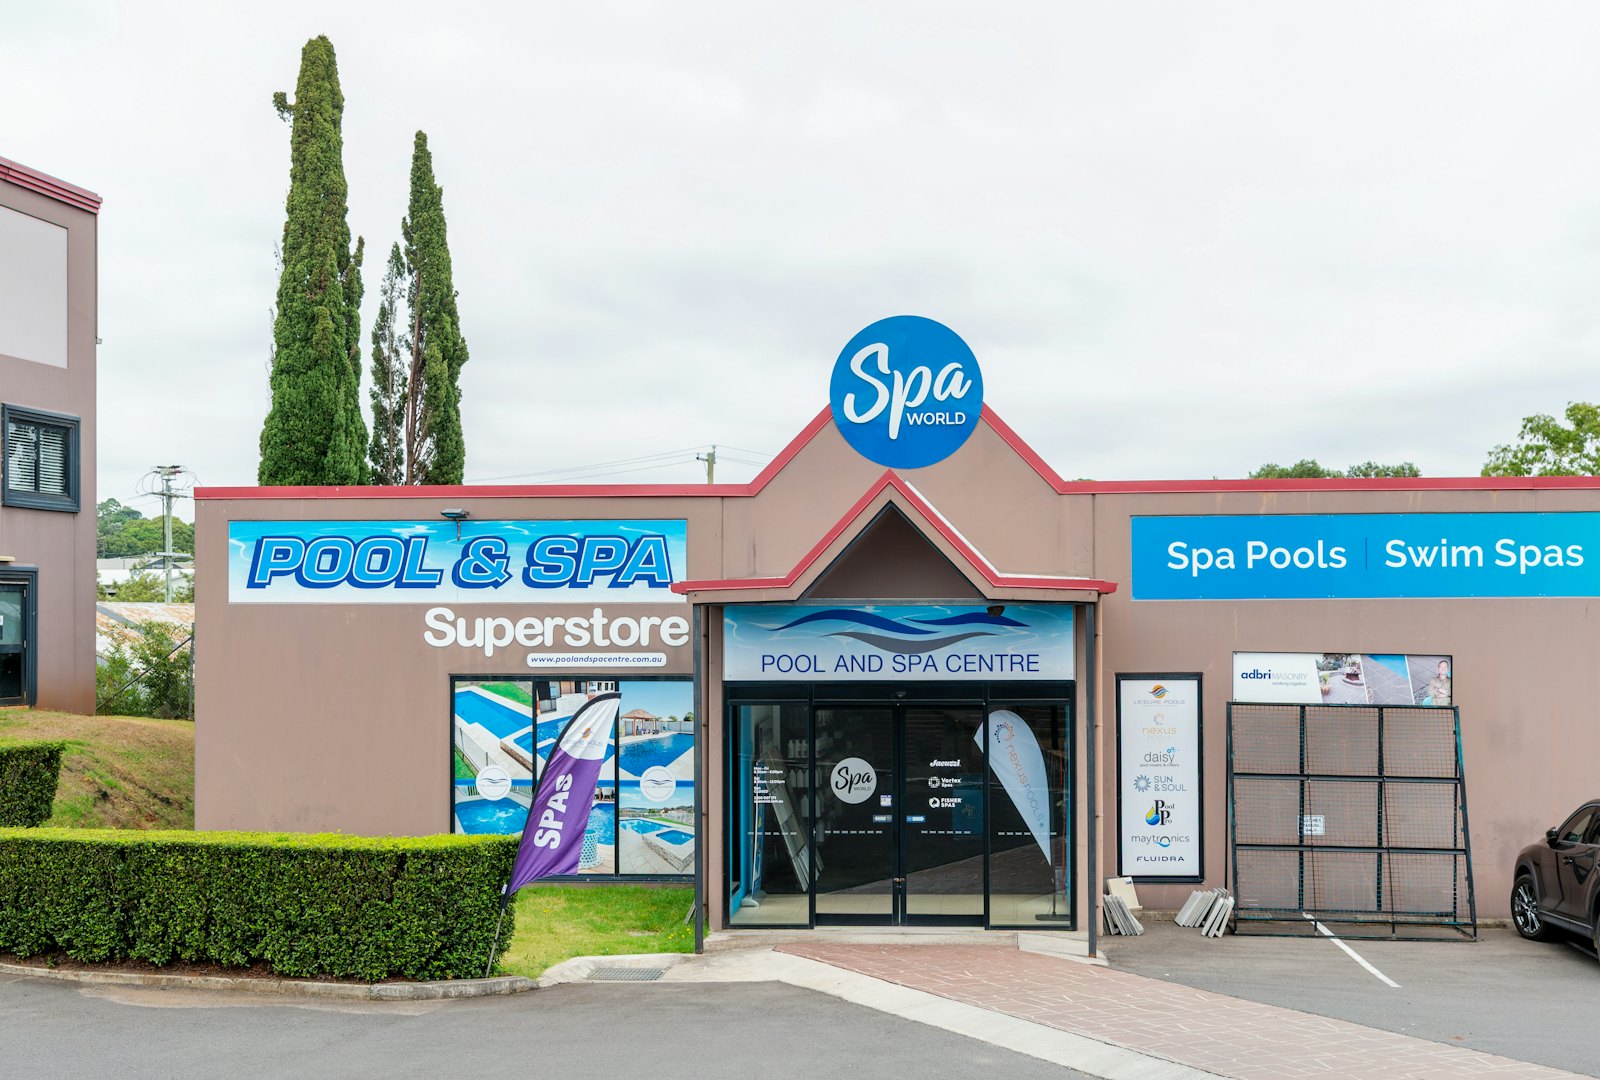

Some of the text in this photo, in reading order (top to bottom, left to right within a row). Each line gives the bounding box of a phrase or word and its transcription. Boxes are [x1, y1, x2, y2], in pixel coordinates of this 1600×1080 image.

[844, 342, 972, 440] Spa
[906, 411, 966, 426] WORLD
[247, 535, 673, 590] POOL & SPA
[1167, 539, 1347, 577] Spa Pools
[1385, 538, 1584, 575] Swim Spas
[423, 607, 689, 657] Superstore
[530, 655, 663, 665] www.poolandspacentre.com.au
[761, 654, 1039, 673] POOL AND SPA CENTRE
[1241, 669, 1271, 680] adbri
[1142, 727, 1177, 735] nexus
[929, 759, 961, 767] Jacuzzi
[1143, 751, 1175, 765] daisy
[835, 766, 873, 794] Spa
[1006, 744, 1044, 822] nexus POOLS
[533, 773, 573, 850] SPAS
[1154, 800, 1175, 815] Pool
